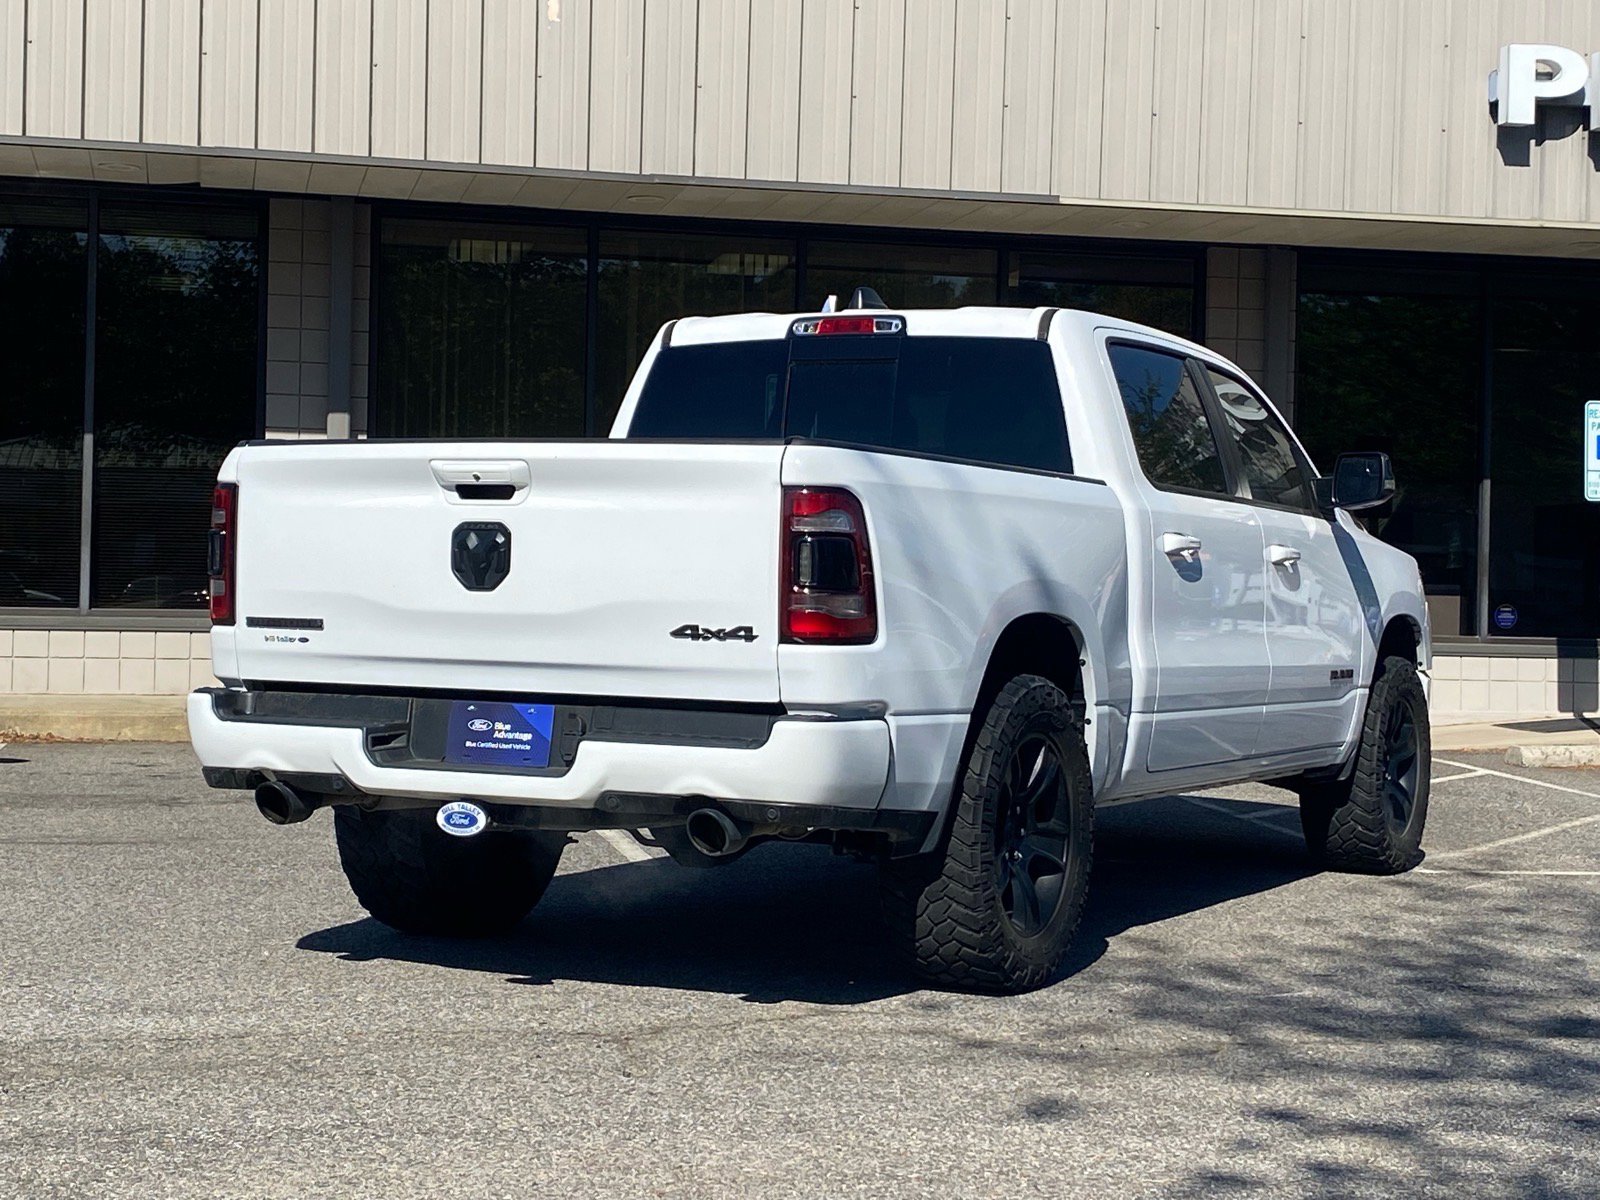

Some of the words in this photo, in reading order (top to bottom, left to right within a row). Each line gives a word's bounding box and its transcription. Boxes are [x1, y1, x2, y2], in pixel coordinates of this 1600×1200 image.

[669, 624, 759, 642] 4x4
[469, 720, 491, 731] Ford
[494, 721, 511, 731] Blue
[493, 730, 533, 741] Advantage
[465, 740, 477, 748] Blue
[477, 741, 499, 749] Certified
[499, 742, 512, 750] Used
[512, 743, 532, 751] Vehicle
[457, 803, 481, 816] TALLEY
[449, 812, 471, 825] Ford
